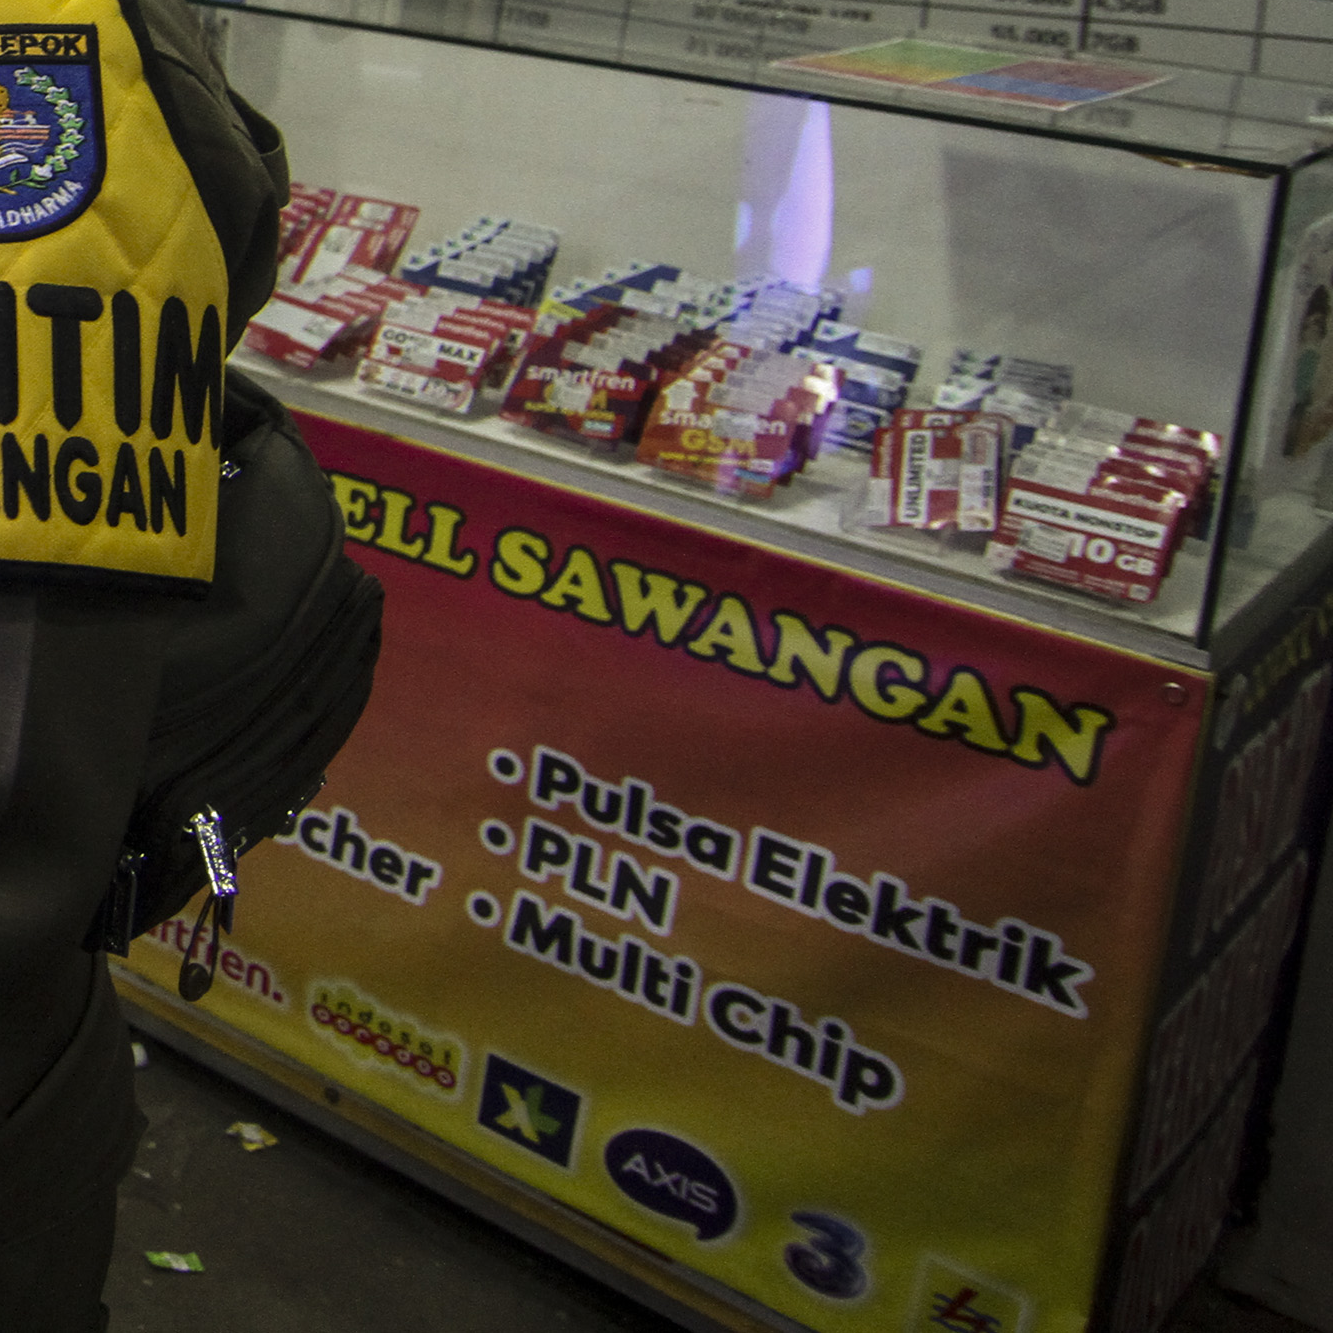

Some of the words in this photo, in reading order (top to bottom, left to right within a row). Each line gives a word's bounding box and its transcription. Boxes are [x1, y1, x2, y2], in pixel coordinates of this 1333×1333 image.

[436, 343, 480, 362] MAX
[659, 410, 786, 436] smaen
[903, 433, 927, 520] UNLIMITED
[1069, 534, 1116, 564] 10
[1115, 553, 1156, 576] GB
[490, 528, 1117, 787] SAWANGAN
[288, 808, 440, 903] cher
[523, 820, 676, 931] PLN
[534, 747, 738, 879] Pulsa
[747, 829, 1091, 1016] Elektrik
[146, 917, 284, 1003] rtfen.
[509, 894, 700, 1022] Multi
[706, 984, 903, 1113] Chip
[621, 1150, 719, 1217] AXIS
